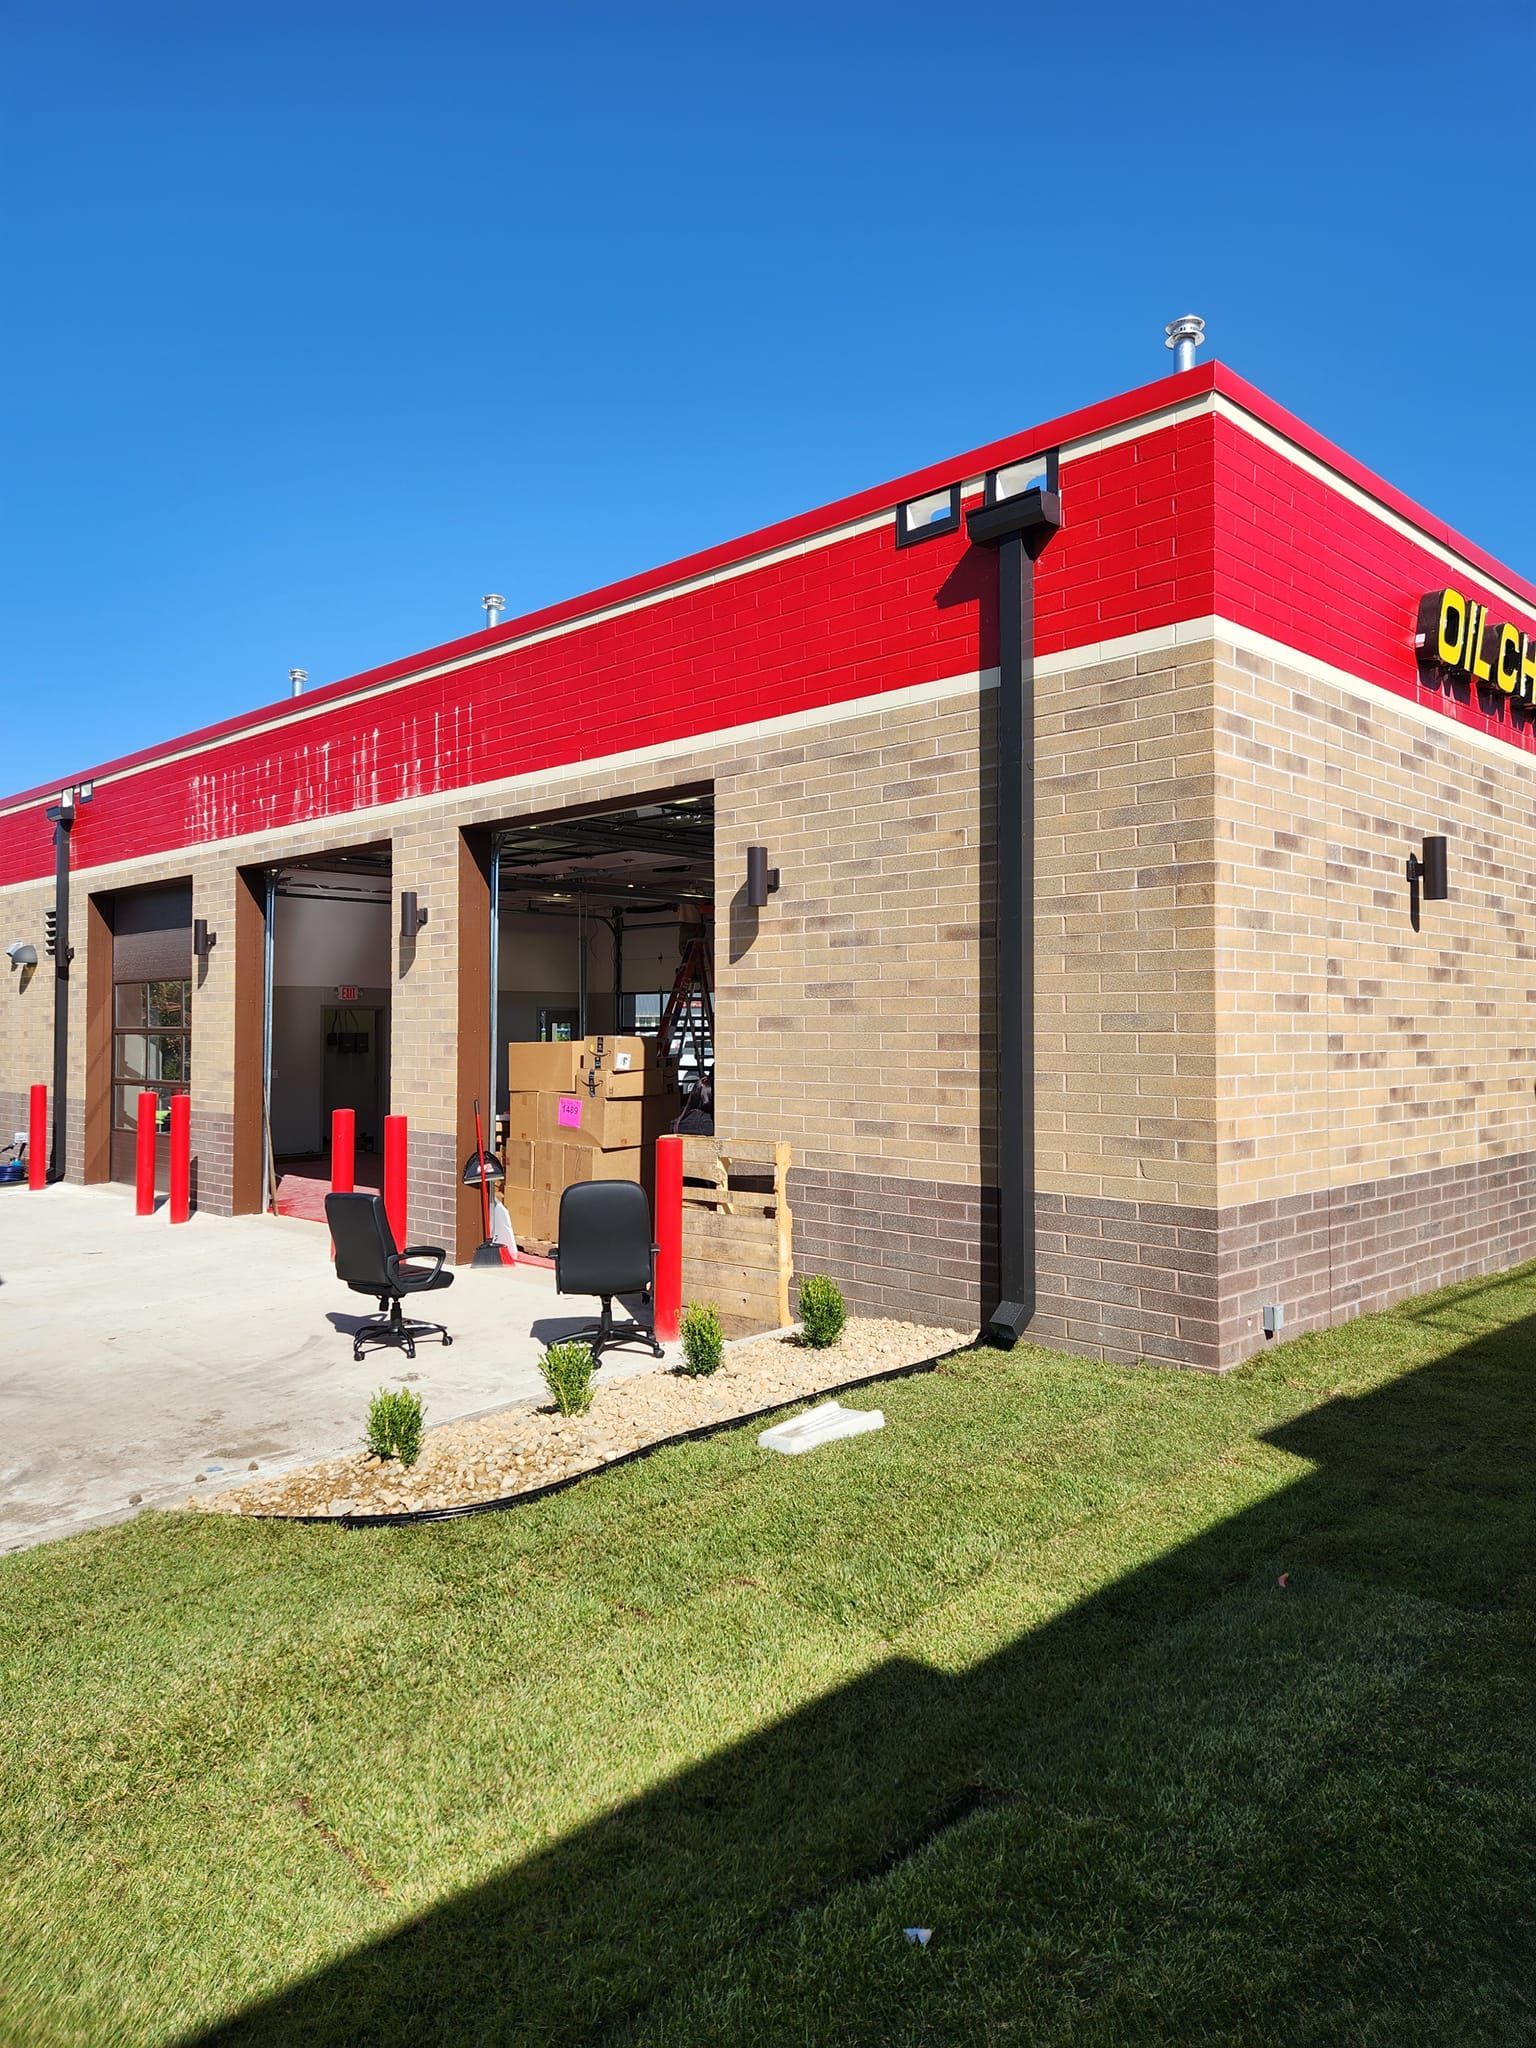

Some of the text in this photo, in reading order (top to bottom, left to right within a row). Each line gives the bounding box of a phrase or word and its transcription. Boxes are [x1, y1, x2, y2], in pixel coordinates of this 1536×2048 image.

[1438, 588, 1536, 705] OIL CH
[341, 987, 356, 999] EXIT
